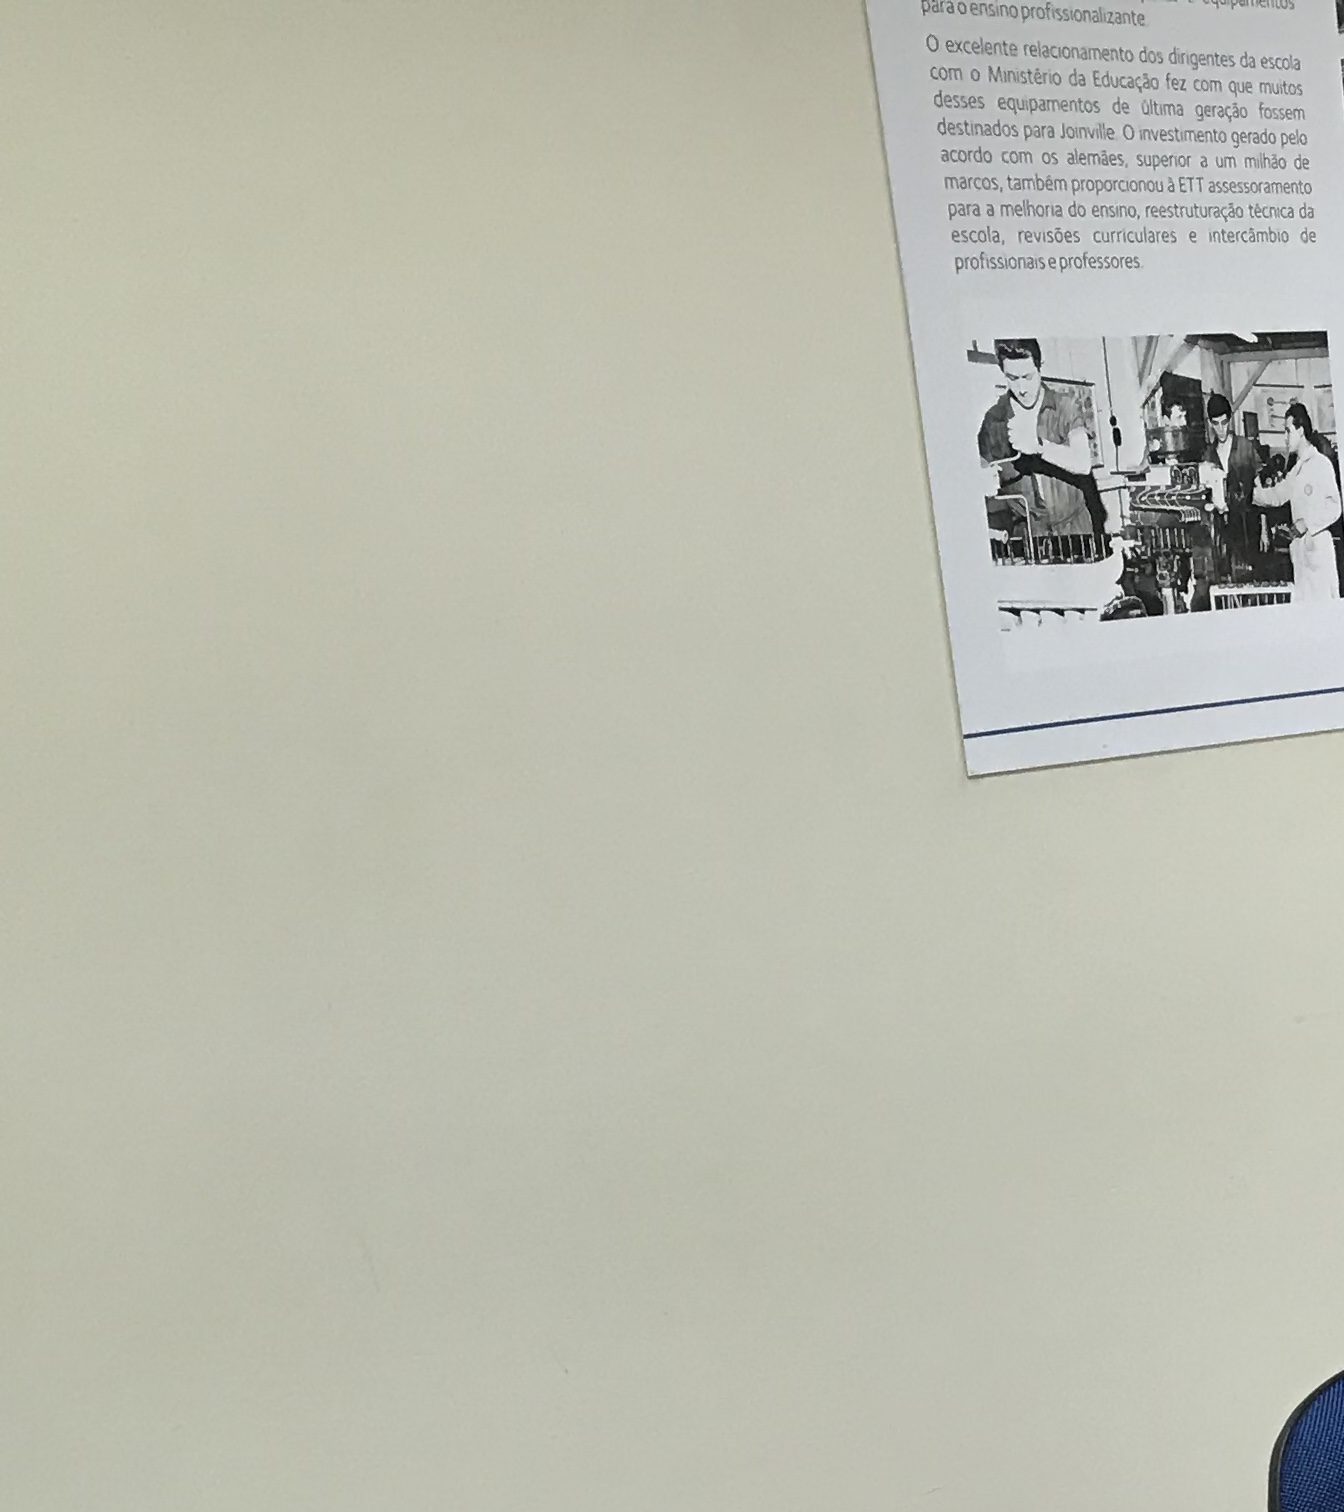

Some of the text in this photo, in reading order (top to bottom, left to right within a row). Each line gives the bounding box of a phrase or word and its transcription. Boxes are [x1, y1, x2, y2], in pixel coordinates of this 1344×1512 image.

[969, 3, 1018, 18] ensino
[925, 34, 1300, 70] O excelente relacionamento dos dirigentes da escola
[929, 66, 1302, 97] com Ministério Educação fez com que muitos
[933, 90, 1305, 122] desses equipamentos última geração fossem
[936, 117, 1019, 137] destinados
[1023, 125, 1055, 141] para
[1139, 127, 1227, 143] investimento
[1231, 128, 1276, 148] gerado
[1280, 129, 1308, 148] pelo
[940, 146, 992, 163] acordo
[1001, 151, 1033, 164] com
[1136, 149, 1190, 170] superior
[1244, 152, 1286, 169] milhão
[1006, 173, 1067, 191] também
[1071, 178, 1164, 196] proporcionou
[1178, 177, 1203, 193] ETT
[1208, 181, 1312, 195] assessoramento
[947, 203, 981, 220] para
[1000, 199, 1063, 217] melhoria
[1145, 203, 1244, 222] reestruturação
[1248, 203, 1294, 218] técnica
[1017, 228, 1080, 243] revisões
[1093, 227, 1177, 243] curriculares
[1208, 227, 1289, 243] intercâmbio
[954, 252, 1046, 274] profissionais
